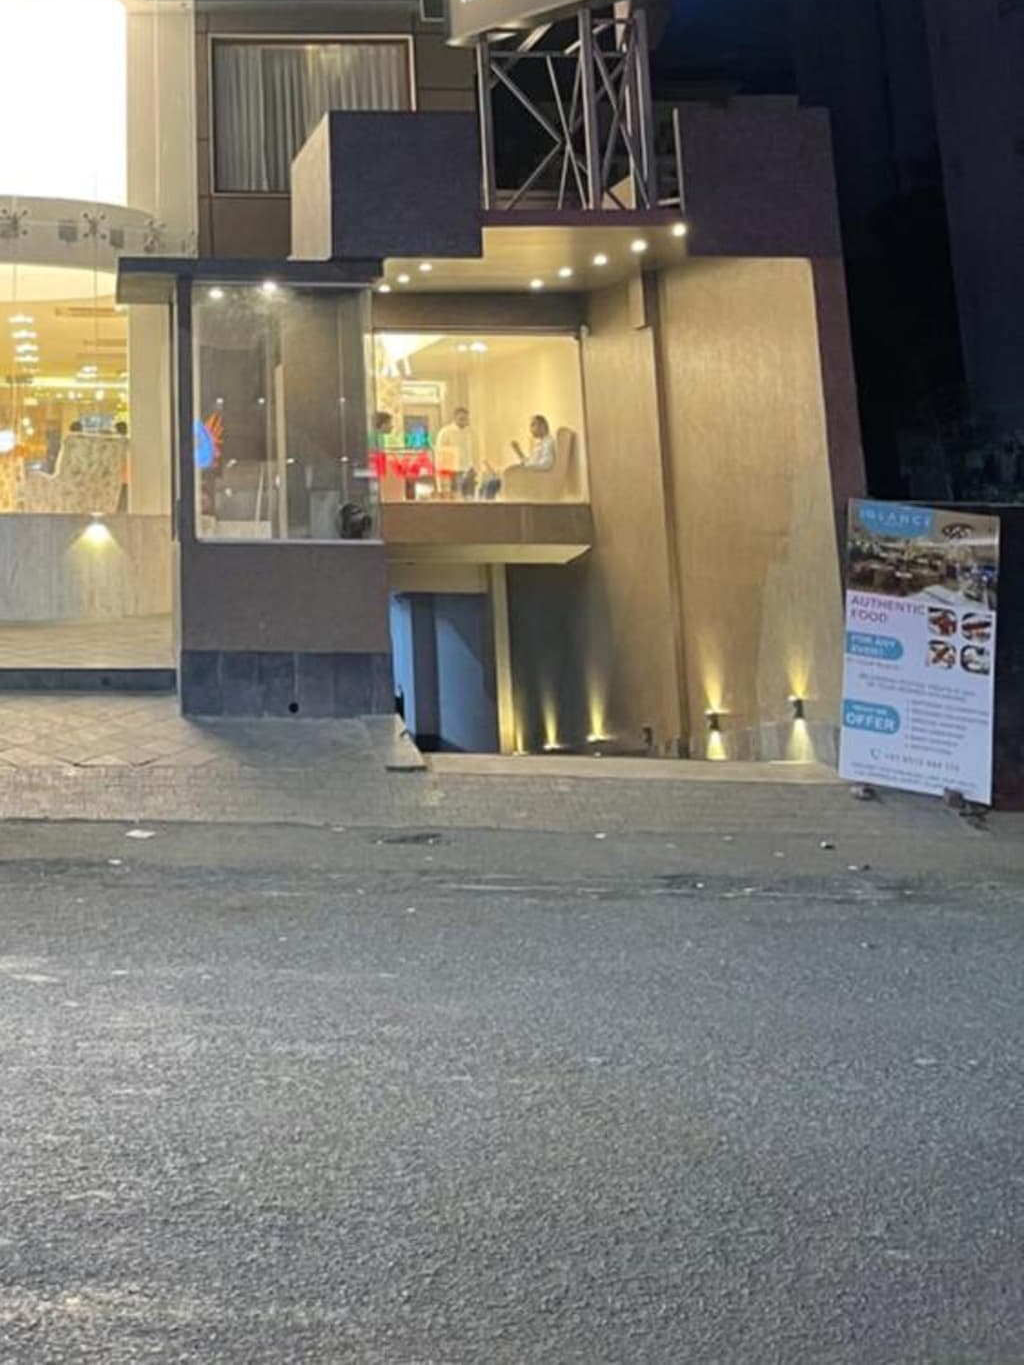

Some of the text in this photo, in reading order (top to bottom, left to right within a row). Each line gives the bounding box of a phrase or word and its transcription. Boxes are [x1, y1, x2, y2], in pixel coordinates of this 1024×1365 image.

[850, 595, 926, 616] AUTHENTIC
[850, 608, 887, 623] FOOD
[845, 712, 895, 732] OFFER
